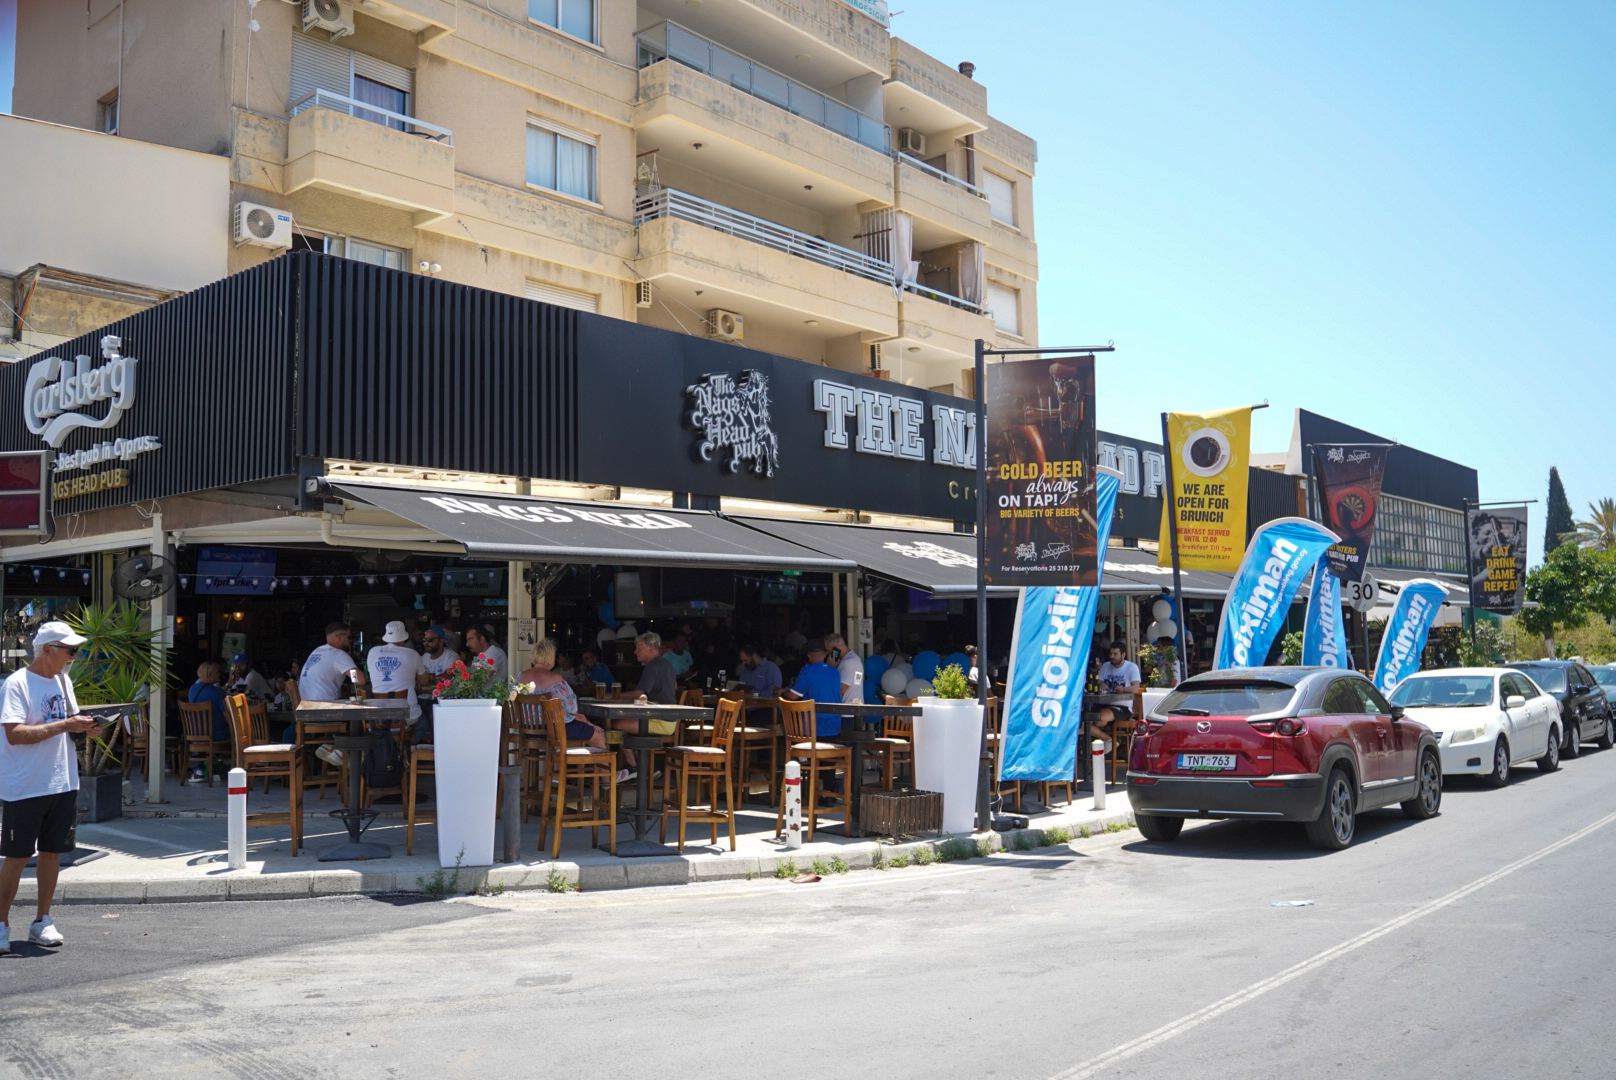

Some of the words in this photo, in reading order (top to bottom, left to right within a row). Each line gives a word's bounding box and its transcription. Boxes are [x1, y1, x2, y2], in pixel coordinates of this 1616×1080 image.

[710, 375, 736, 396] The
[24, 354, 138, 440] Carlsberg
[693, 386, 741, 427] Nags
[813, 379, 926, 461] THE
[59, 453, 79, 470] best
[81, 444, 99, 469] pub
[101, 441, 112, 459] in
[731, 432, 761, 473] pub
[1000, 462, 1039, 480] COLD
[1043, 461, 1083, 479] BEER
[54, 480, 71, 499] AGS
[72, 473, 98, 494] HEAD
[100, 468, 122, 489] PUB
[1026, 473, 1079, 505] always
[1183, 483, 1200, 495] WE
[1203, 484, 1225, 496] ARE
[998, 495, 1020, 507] ON
[1025, 493, 1058, 507] TAP!
[1177, 497, 1205, 508] OPEN
[1208, 498, 1229, 509] FOR
[1000, 509, 1012, 518] BIG
[1013, 509, 1044, 518] VARIETY
[1045, 508, 1054, 517] OF
[1055, 508, 1080, 517] BEERS
[1180, 510, 1224, 523] BRUNCH
[1184, 535, 1200, 543] UNTIL
[1491, 546, 1509, 557] EAT
[1346, 555, 1359, 563] PUB
[1485, 557, 1517, 569] DRINK
[1488, 568, 1515, 580] GAME
[1352, 583, 1373, 600] 30
[1483, 580, 1519, 592] REPEAT
[1187, 755, 1206, 766] TNT
[1211, 755, 1230, 767] 763
